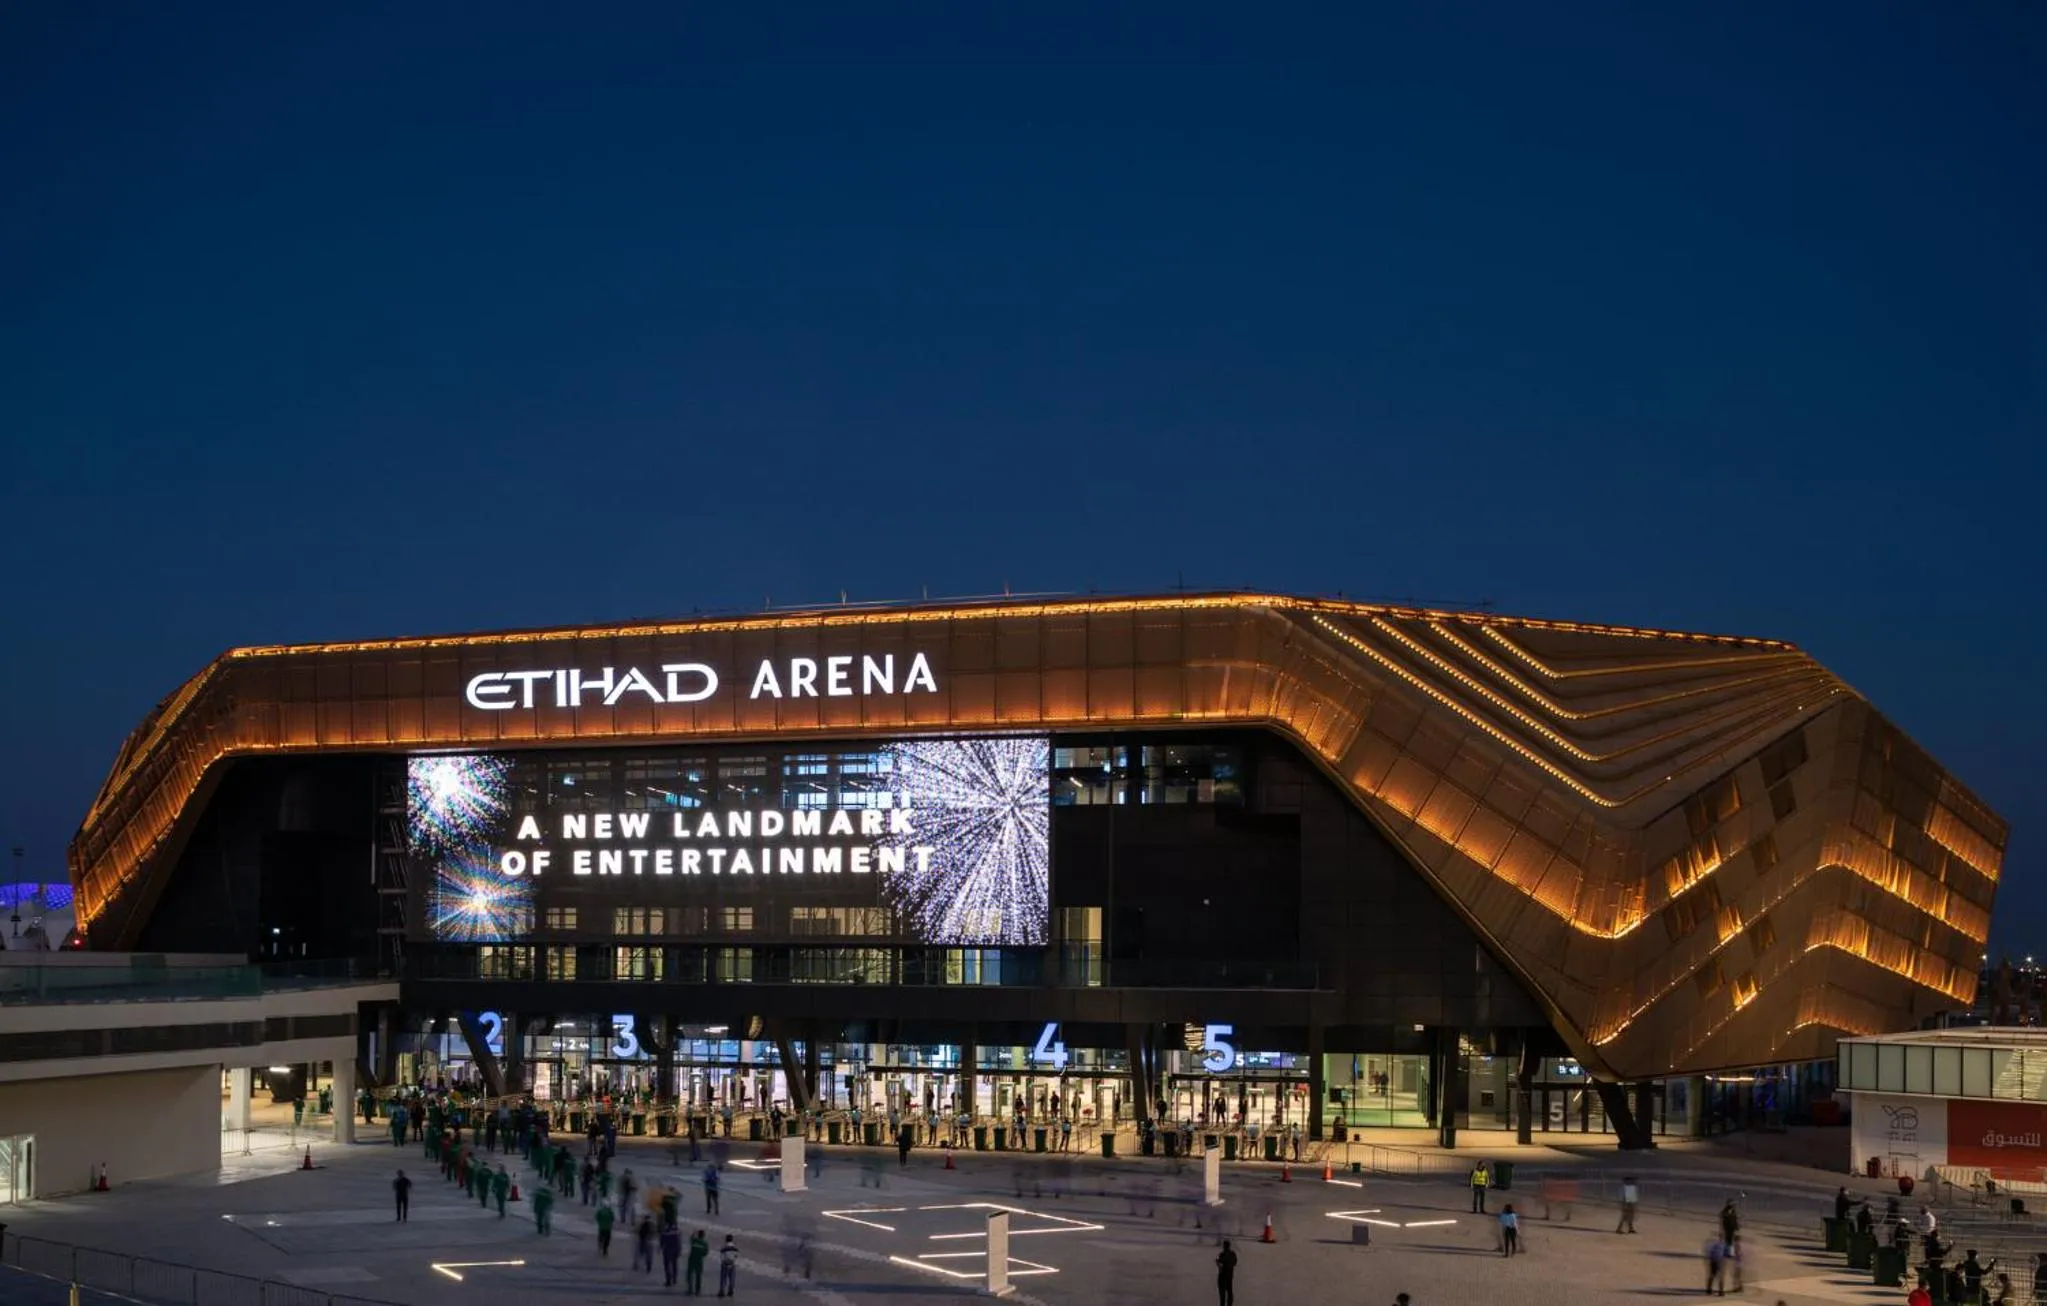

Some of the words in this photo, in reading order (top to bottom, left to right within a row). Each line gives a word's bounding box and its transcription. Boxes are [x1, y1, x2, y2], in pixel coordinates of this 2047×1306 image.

[466, 663, 718, 709] ETIHAD
[750, 652, 937, 699] ARENA
[518, 814, 540, 839] A
[563, 813, 650, 839] NEW
[674, 809, 916, 837] LANDMARK
[501, 849, 551, 876] OF
[573, 846, 935, 875] ENTERTAINMENT
[479, 1011, 503, 1056] 2
[612, 1015, 638, 1057] 3
[1033, 1023, 1068, 1069] 4
[1203, 1024, 1235, 1072] 5
[1549, 1101, 1564, 1122] 5
[1982, 1130, 2041, 1147] للتسوق
